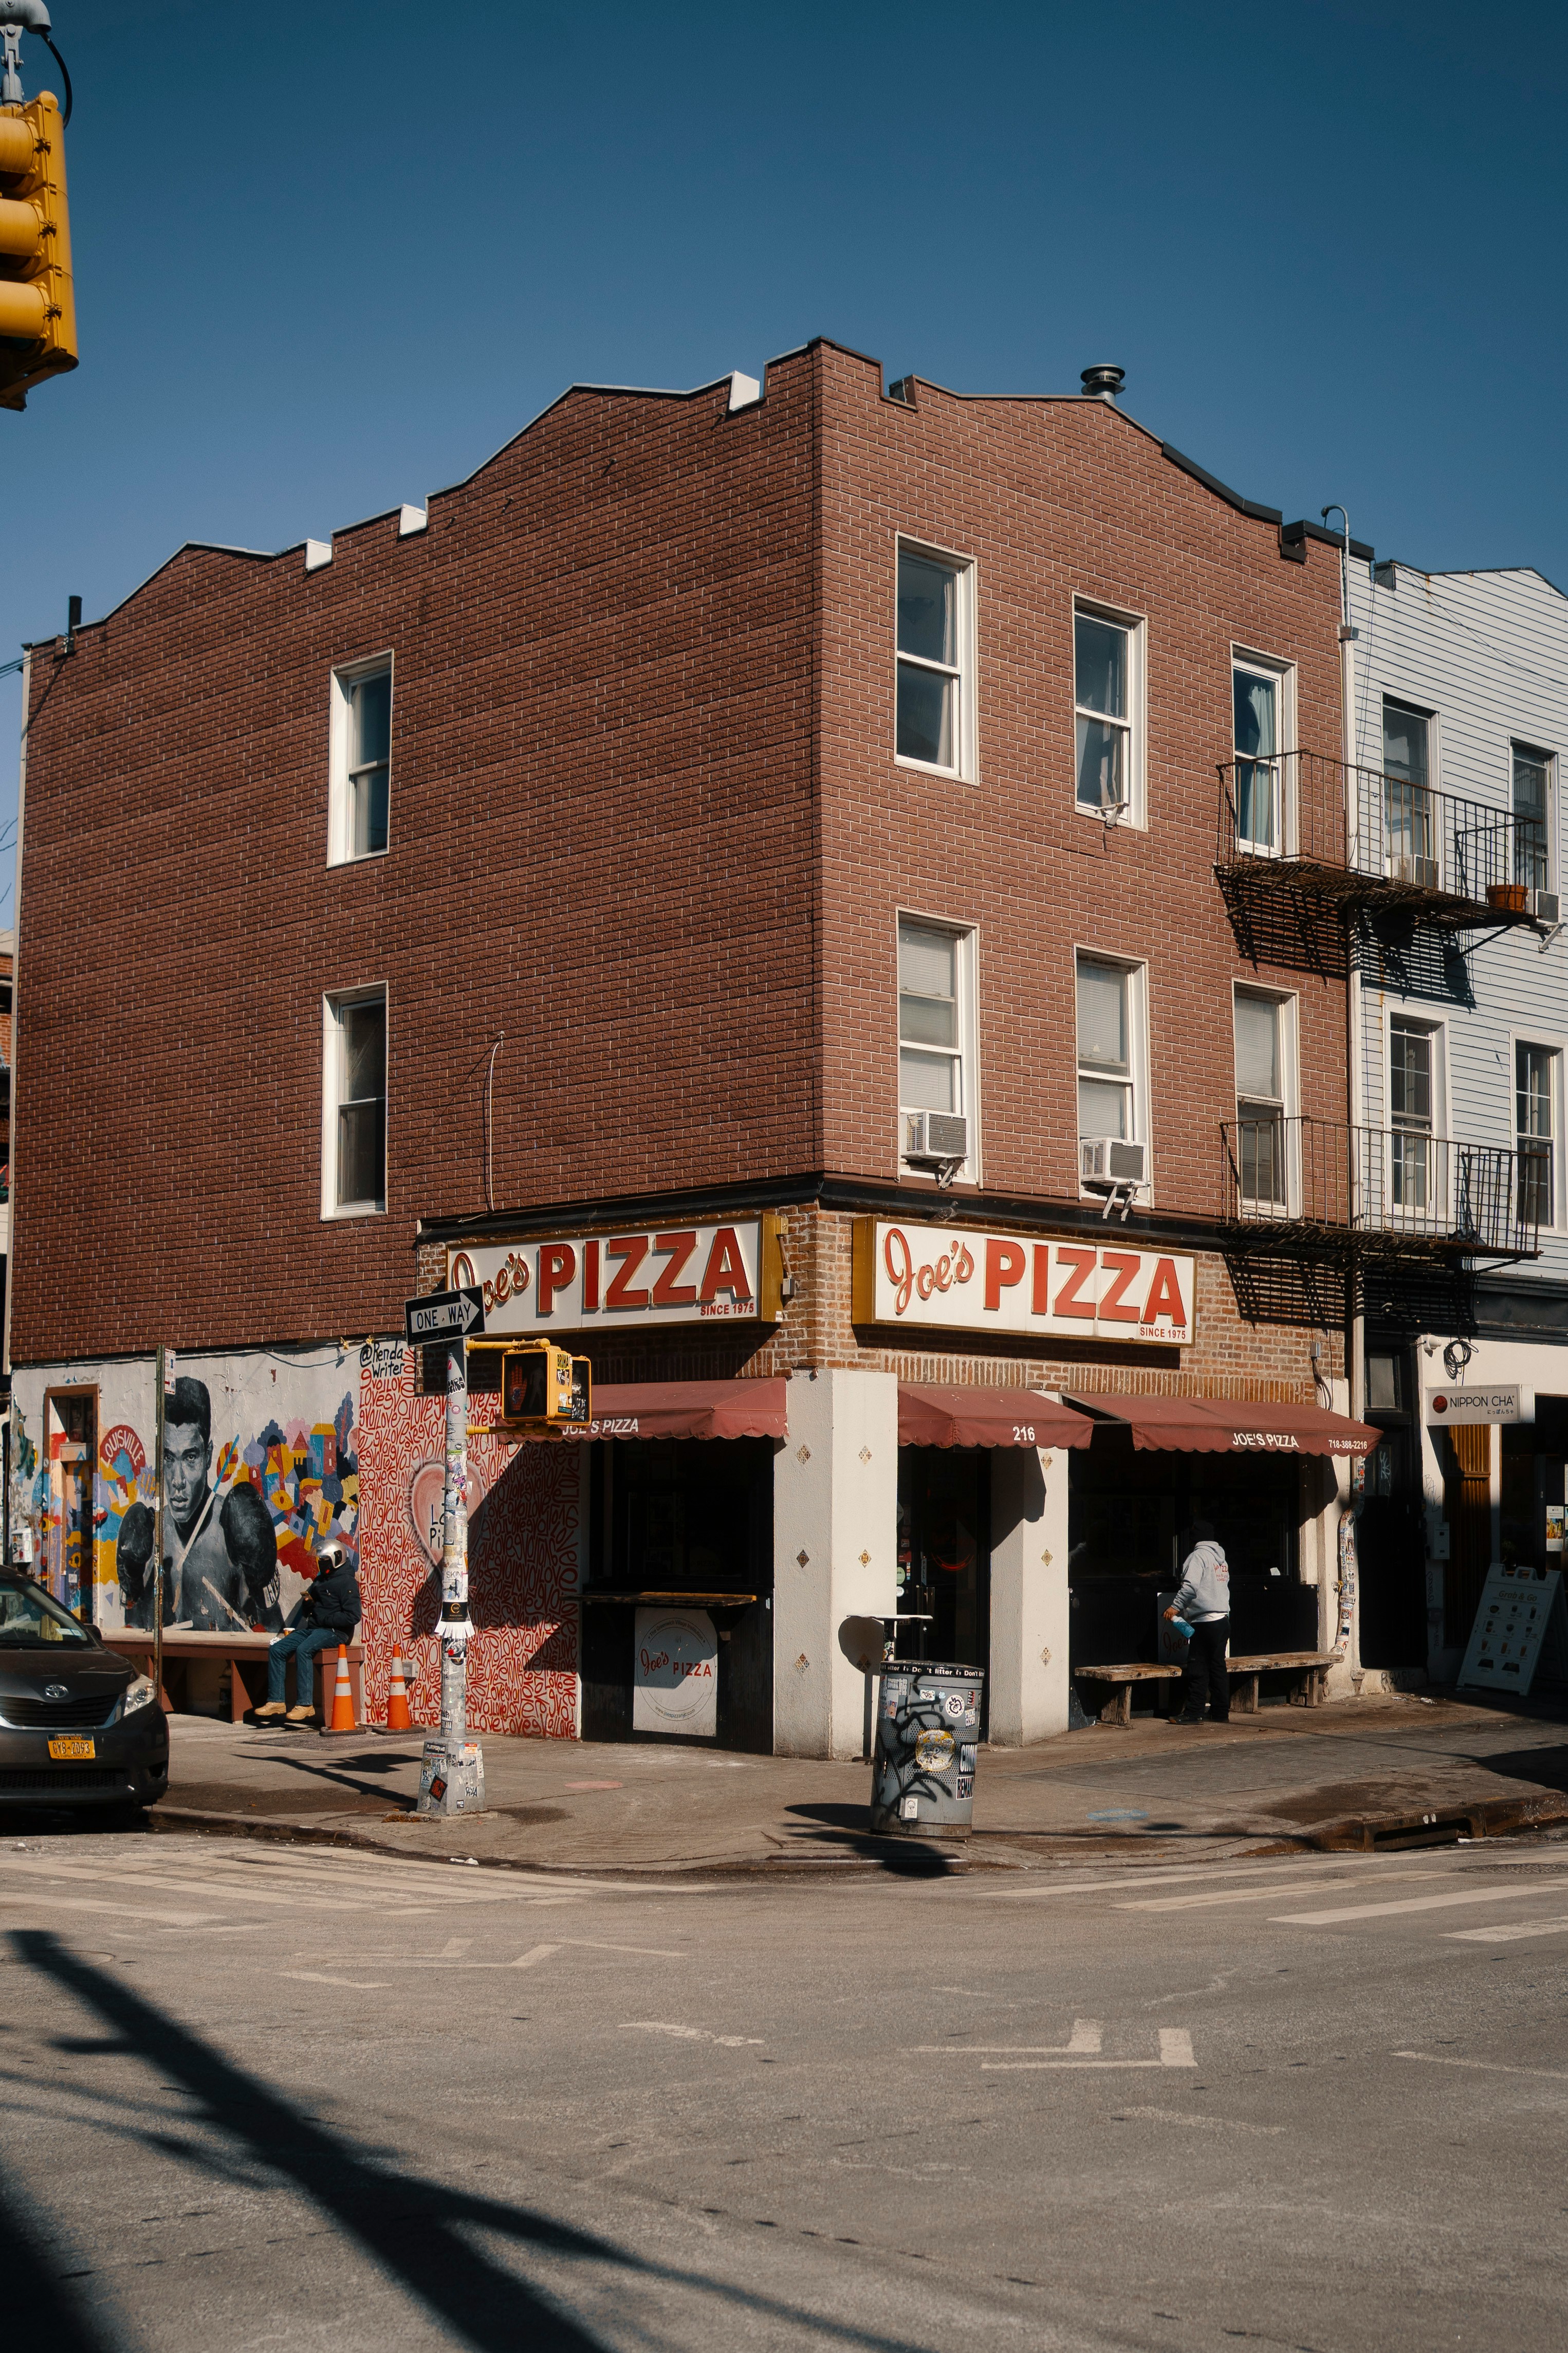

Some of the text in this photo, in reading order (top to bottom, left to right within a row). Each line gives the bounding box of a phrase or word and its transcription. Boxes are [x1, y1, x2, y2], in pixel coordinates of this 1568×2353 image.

[538, 1227, 754, 1312] PIZZA
[882, 1227, 1187, 1327] Joe's PIZZA
[416, 1302, 472, 1330] ONE WAY
[700, 1303, 754, 1317] SINCE 1975
[1140, 1327, 1186, 1340] SINCE 1975
[360, 1340, 403, 1367] @Renda
[372, 1361, 405, 1379] Writer
[1450, 1396, 1488, 1408] NIPPON
[602, 1418, 639, 1433] PIZZA
[1012, 1425, 1036, 1443] 216
[100, 1429, 144, 1468] LOUISVILLE
[1232, 1432, 1300, 1448] JOE'S PIZZA
[1328, 1439, 1368, 1450] 718-388-2216
[1499, 1590, 1518, 1599] Grab
[1527, 1593, 1538, 1602] Go
[656, 1621, 675, 1631] Greenwich
[687, 1622, 704, 1641] Institution
[640, 1648, 712, 1677] Joe's PIZZA
[655, 1705, 696, 1719] www.joespizzanyc.com
